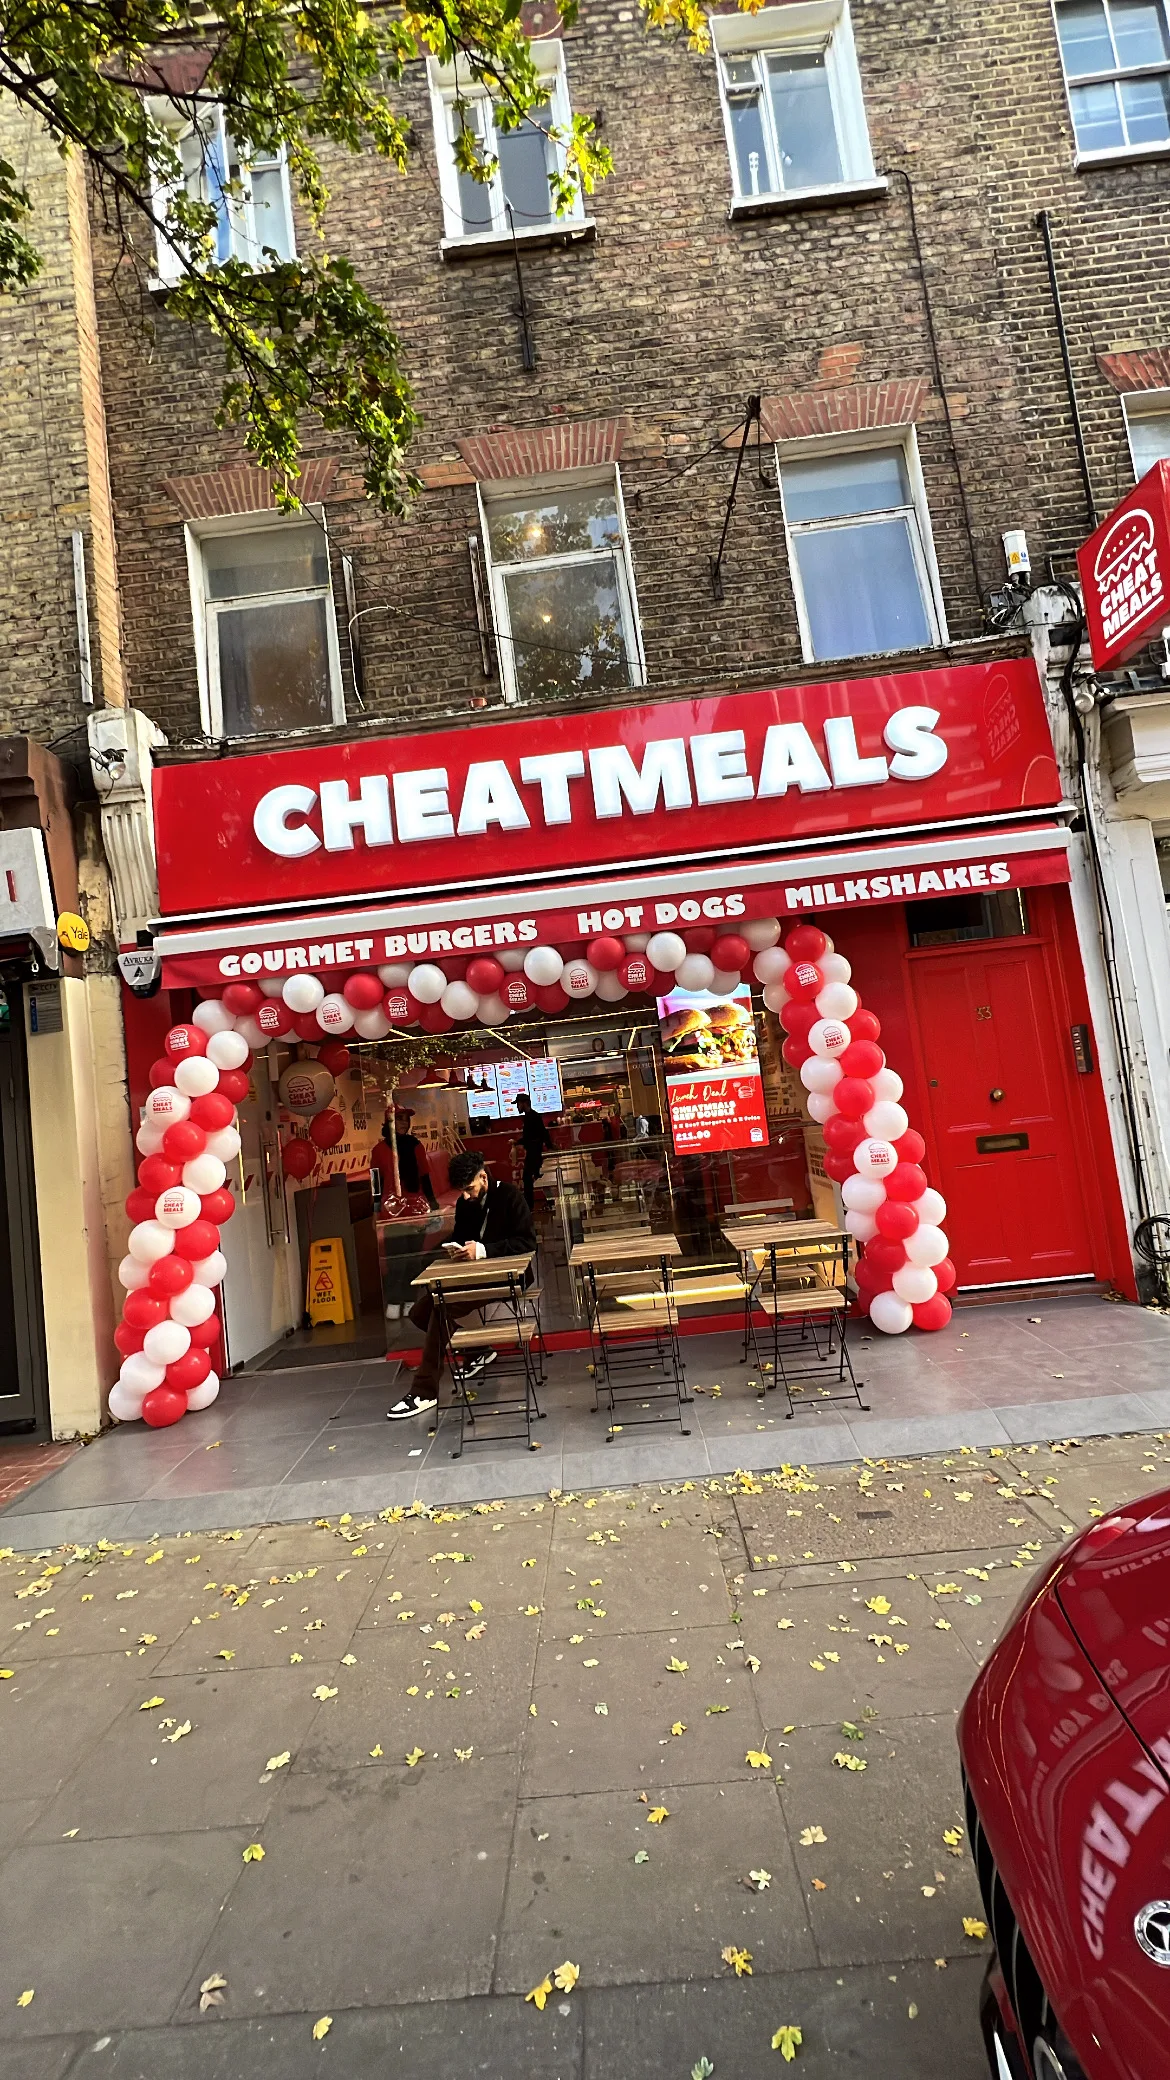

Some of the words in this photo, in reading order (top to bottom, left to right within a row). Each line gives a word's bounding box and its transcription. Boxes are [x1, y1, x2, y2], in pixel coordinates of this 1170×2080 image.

[1101, 549, 1158, 617] CHEAT
[1103, 572, 1163, 640] MEALS
[252, 705, 948, 858] CHEATMEALS
[71, 926, 88, 940] Yale
[219, 939, 374, 977] GOURMET
[386, 919, 538, 958] BURGERS
[578, 905, 645, 934] HOT
[656, 894, 746, 925] DOGS
[785, 862, 1011, 909] MILKSHAKES
[826, 1035, 843, 1043] CHEAT
[289, 1091, 315, 1100] CHEAT
[671, 1084, 698, 1105] Lunch
[703, 1080, 727, 1101] Deal
